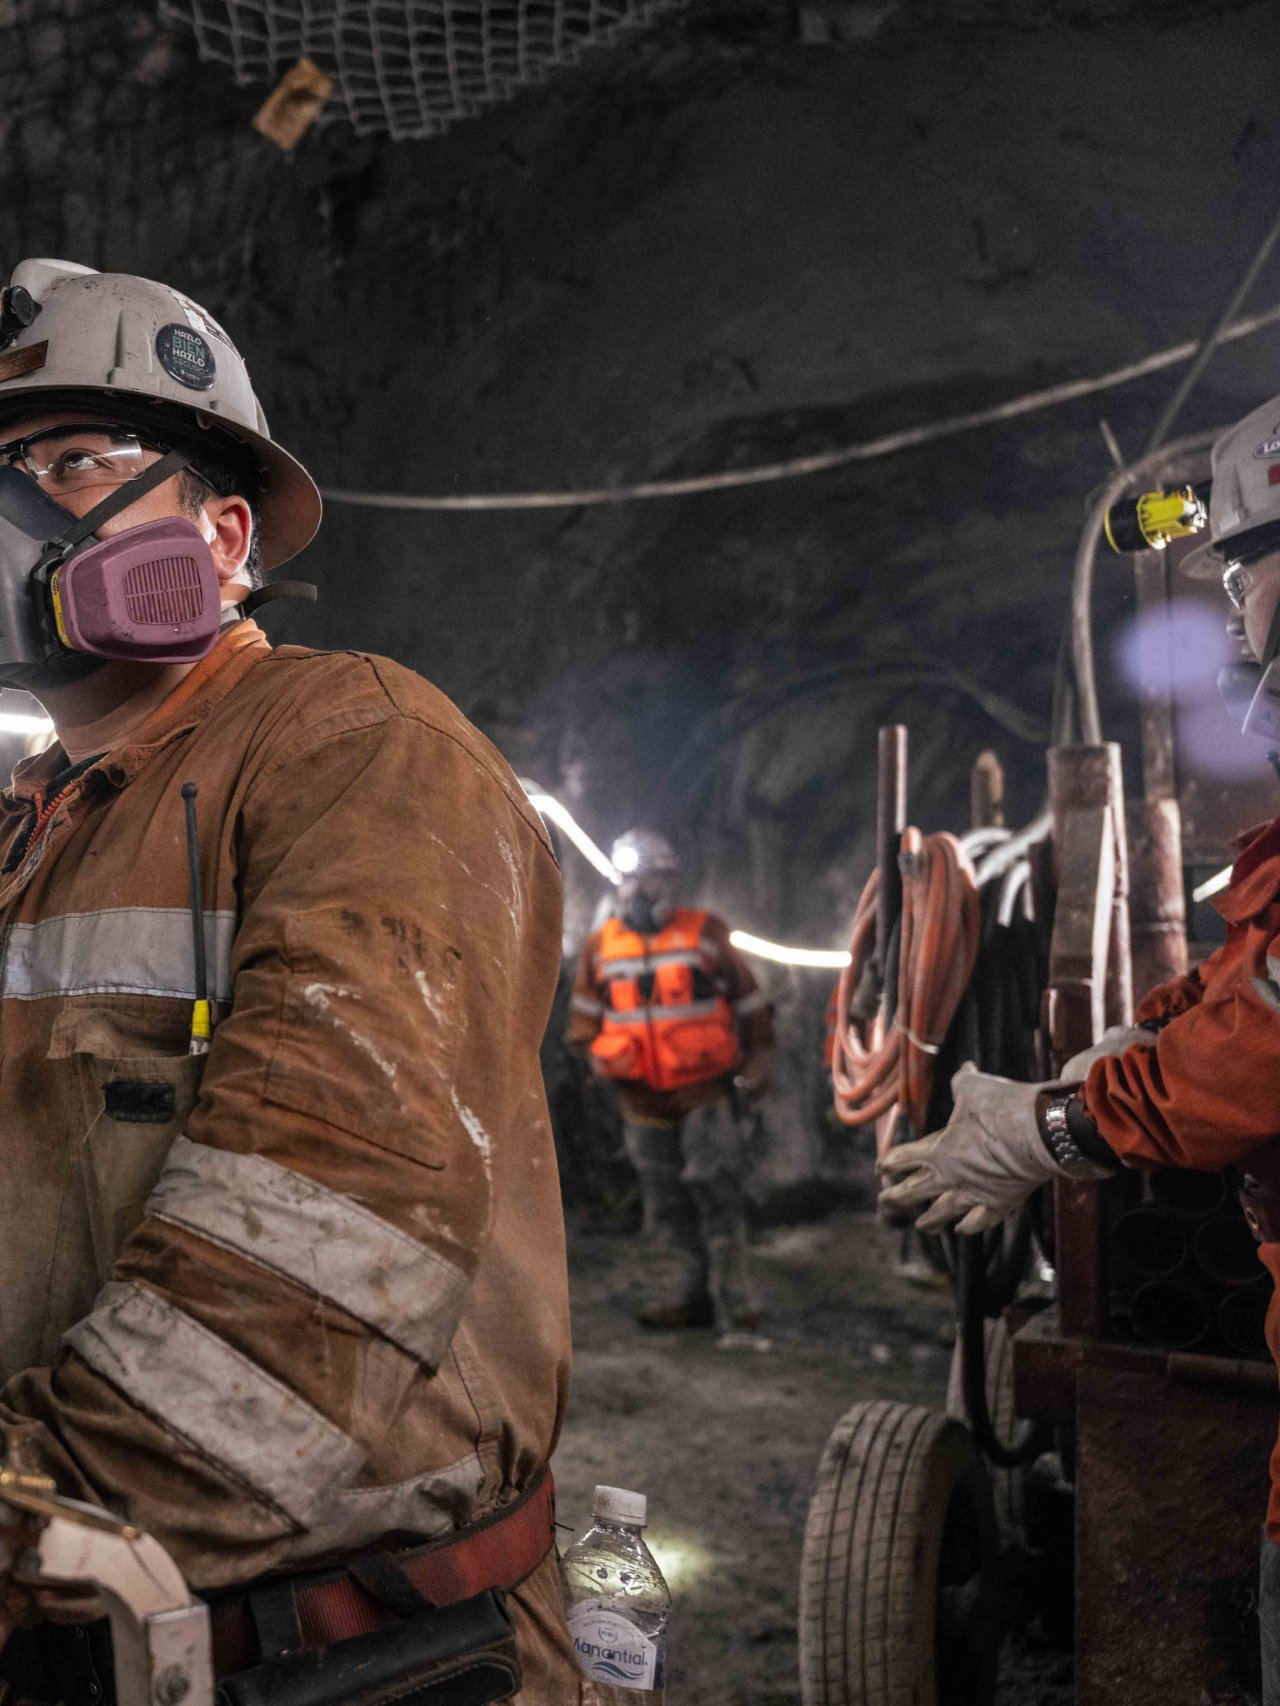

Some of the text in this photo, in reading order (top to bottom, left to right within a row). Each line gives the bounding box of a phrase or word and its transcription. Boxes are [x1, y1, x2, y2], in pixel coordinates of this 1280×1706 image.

[174, 329, 202, 345] HAZLO
[172, 336, 205, 359] BIEN
[172, 347, 205, 367] HAZLO
[172, 356, 205, 375] SEGURO
